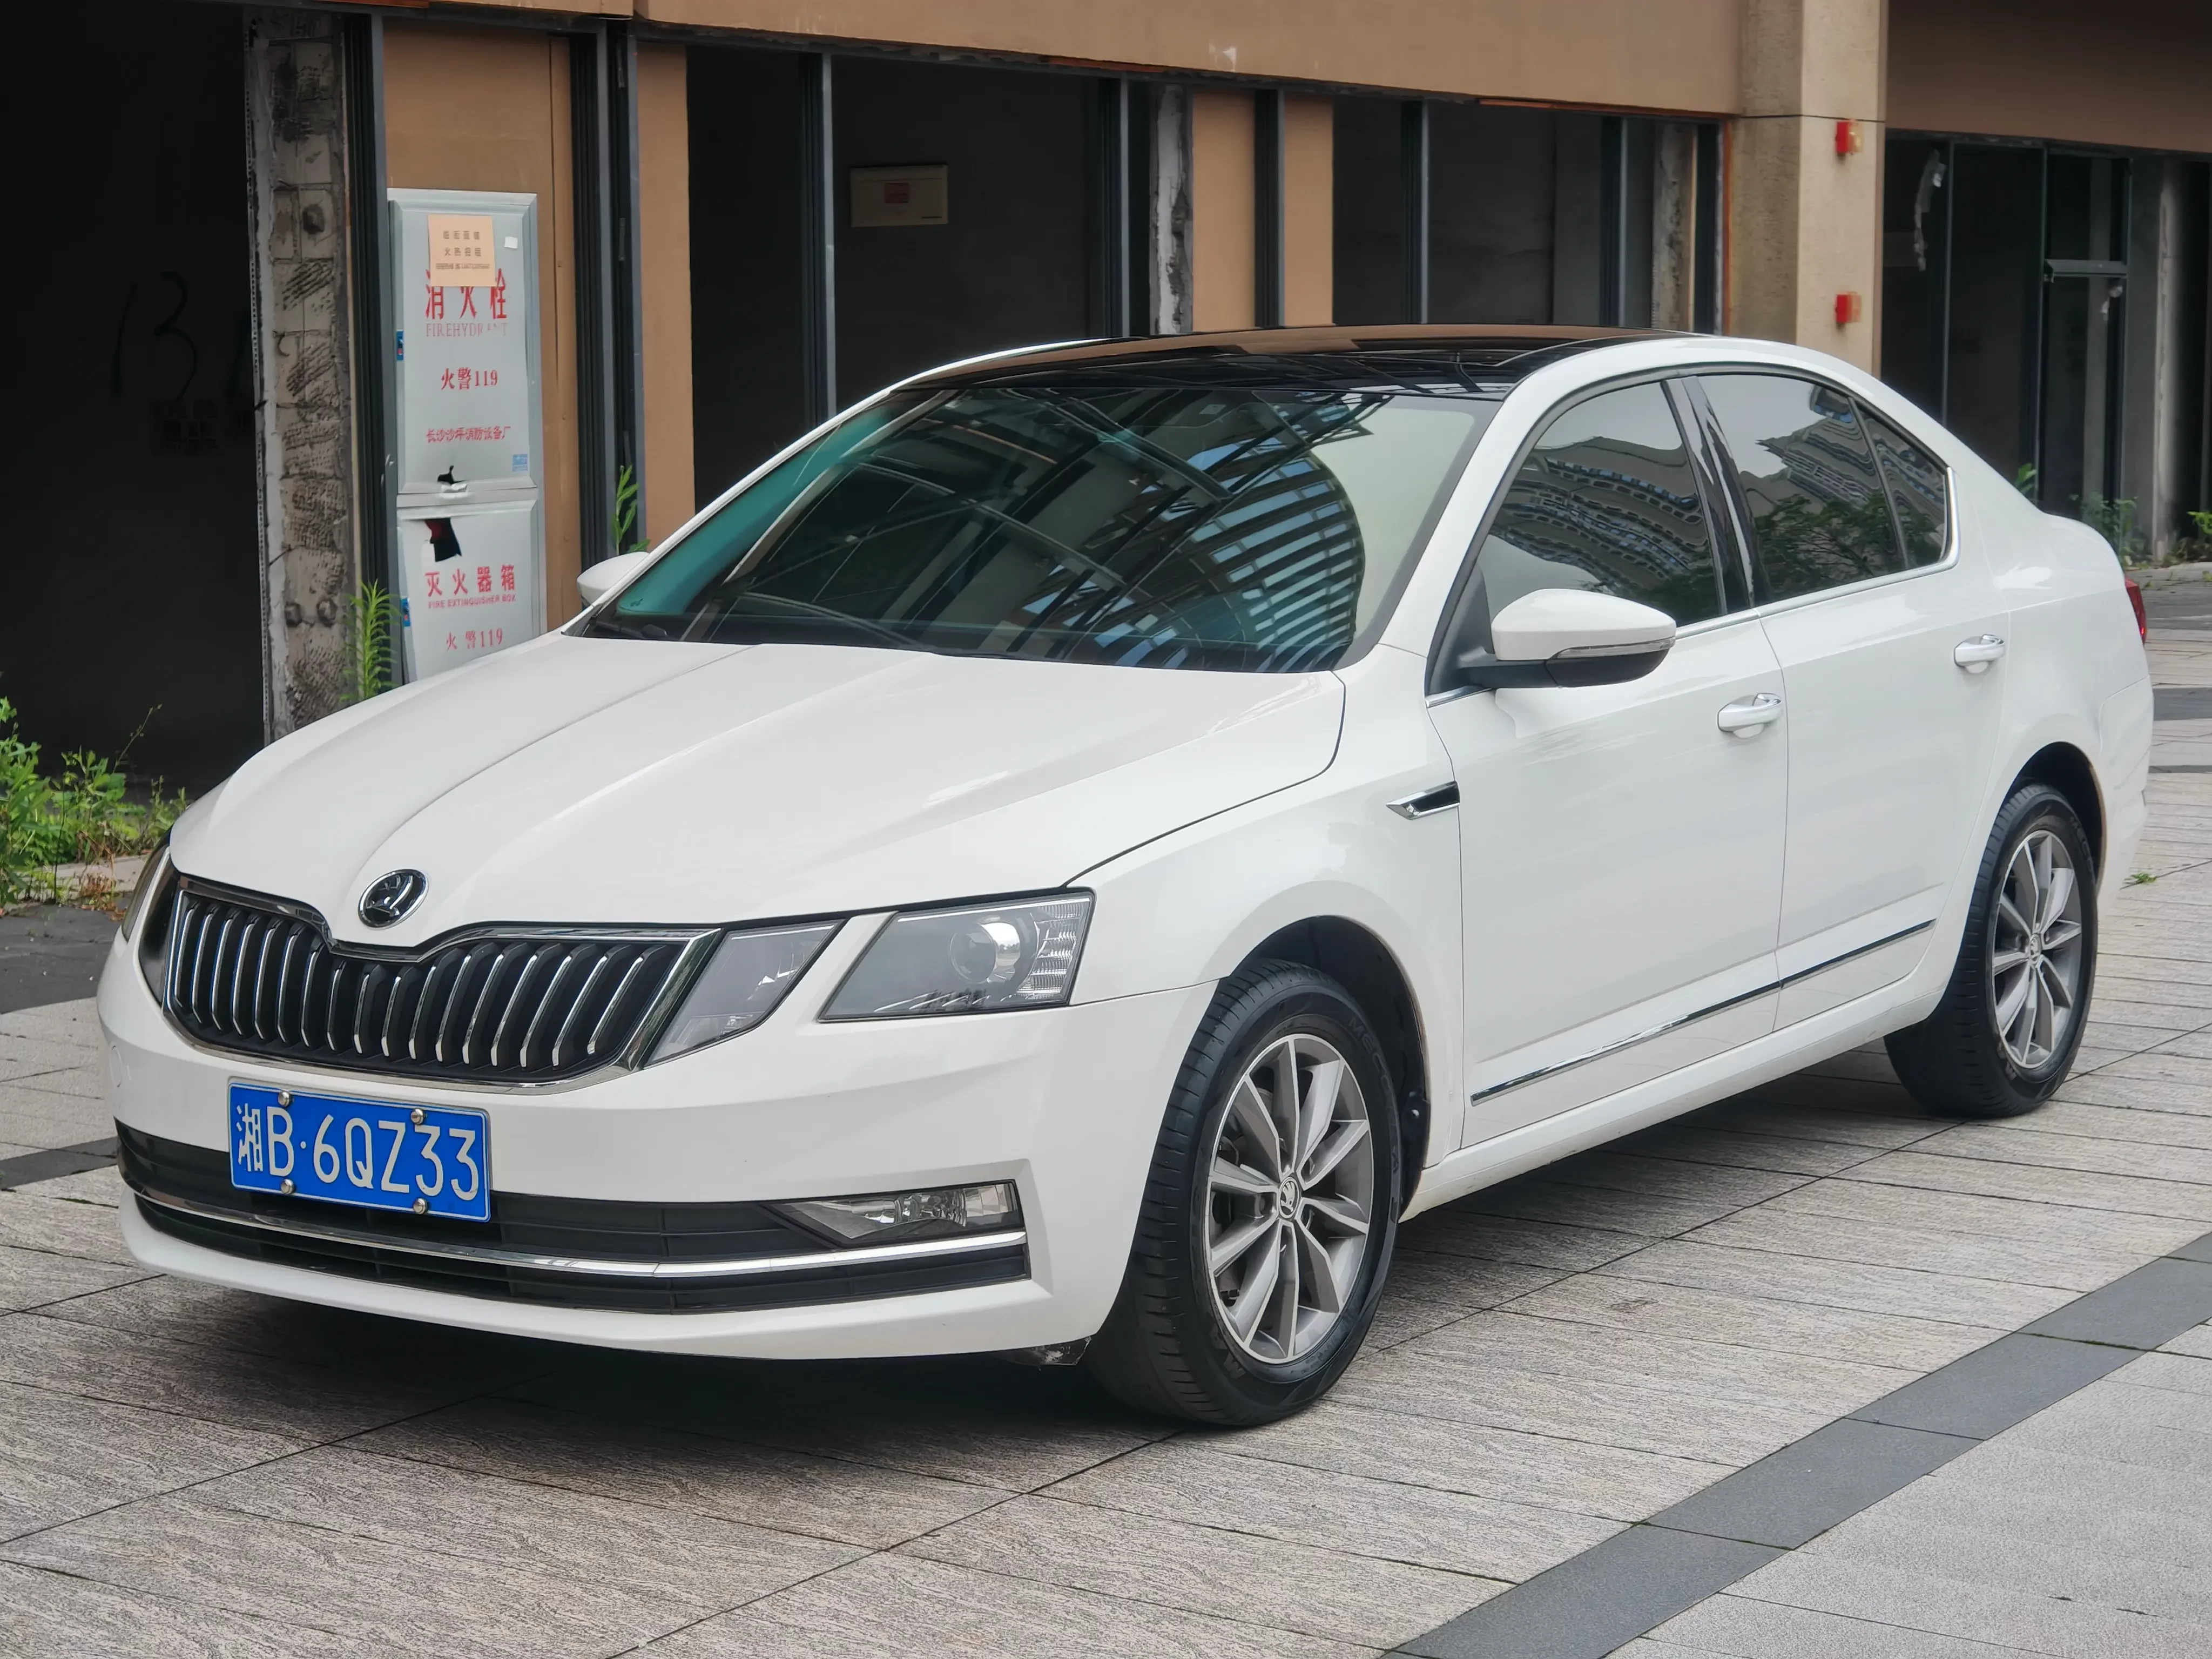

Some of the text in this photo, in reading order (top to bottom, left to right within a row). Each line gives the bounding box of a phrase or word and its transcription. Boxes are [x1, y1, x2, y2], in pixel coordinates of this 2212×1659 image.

[441, 367, 498, 390] 火警119
[424, 564, 515, 597] 灭火器箱
[428, 594, 516, 609] FIRE EXTINGUISHER BOX
[446, 628, 503, 652] 火警119
[237, 1103, 480, 1201] 湘B·6QZ33
